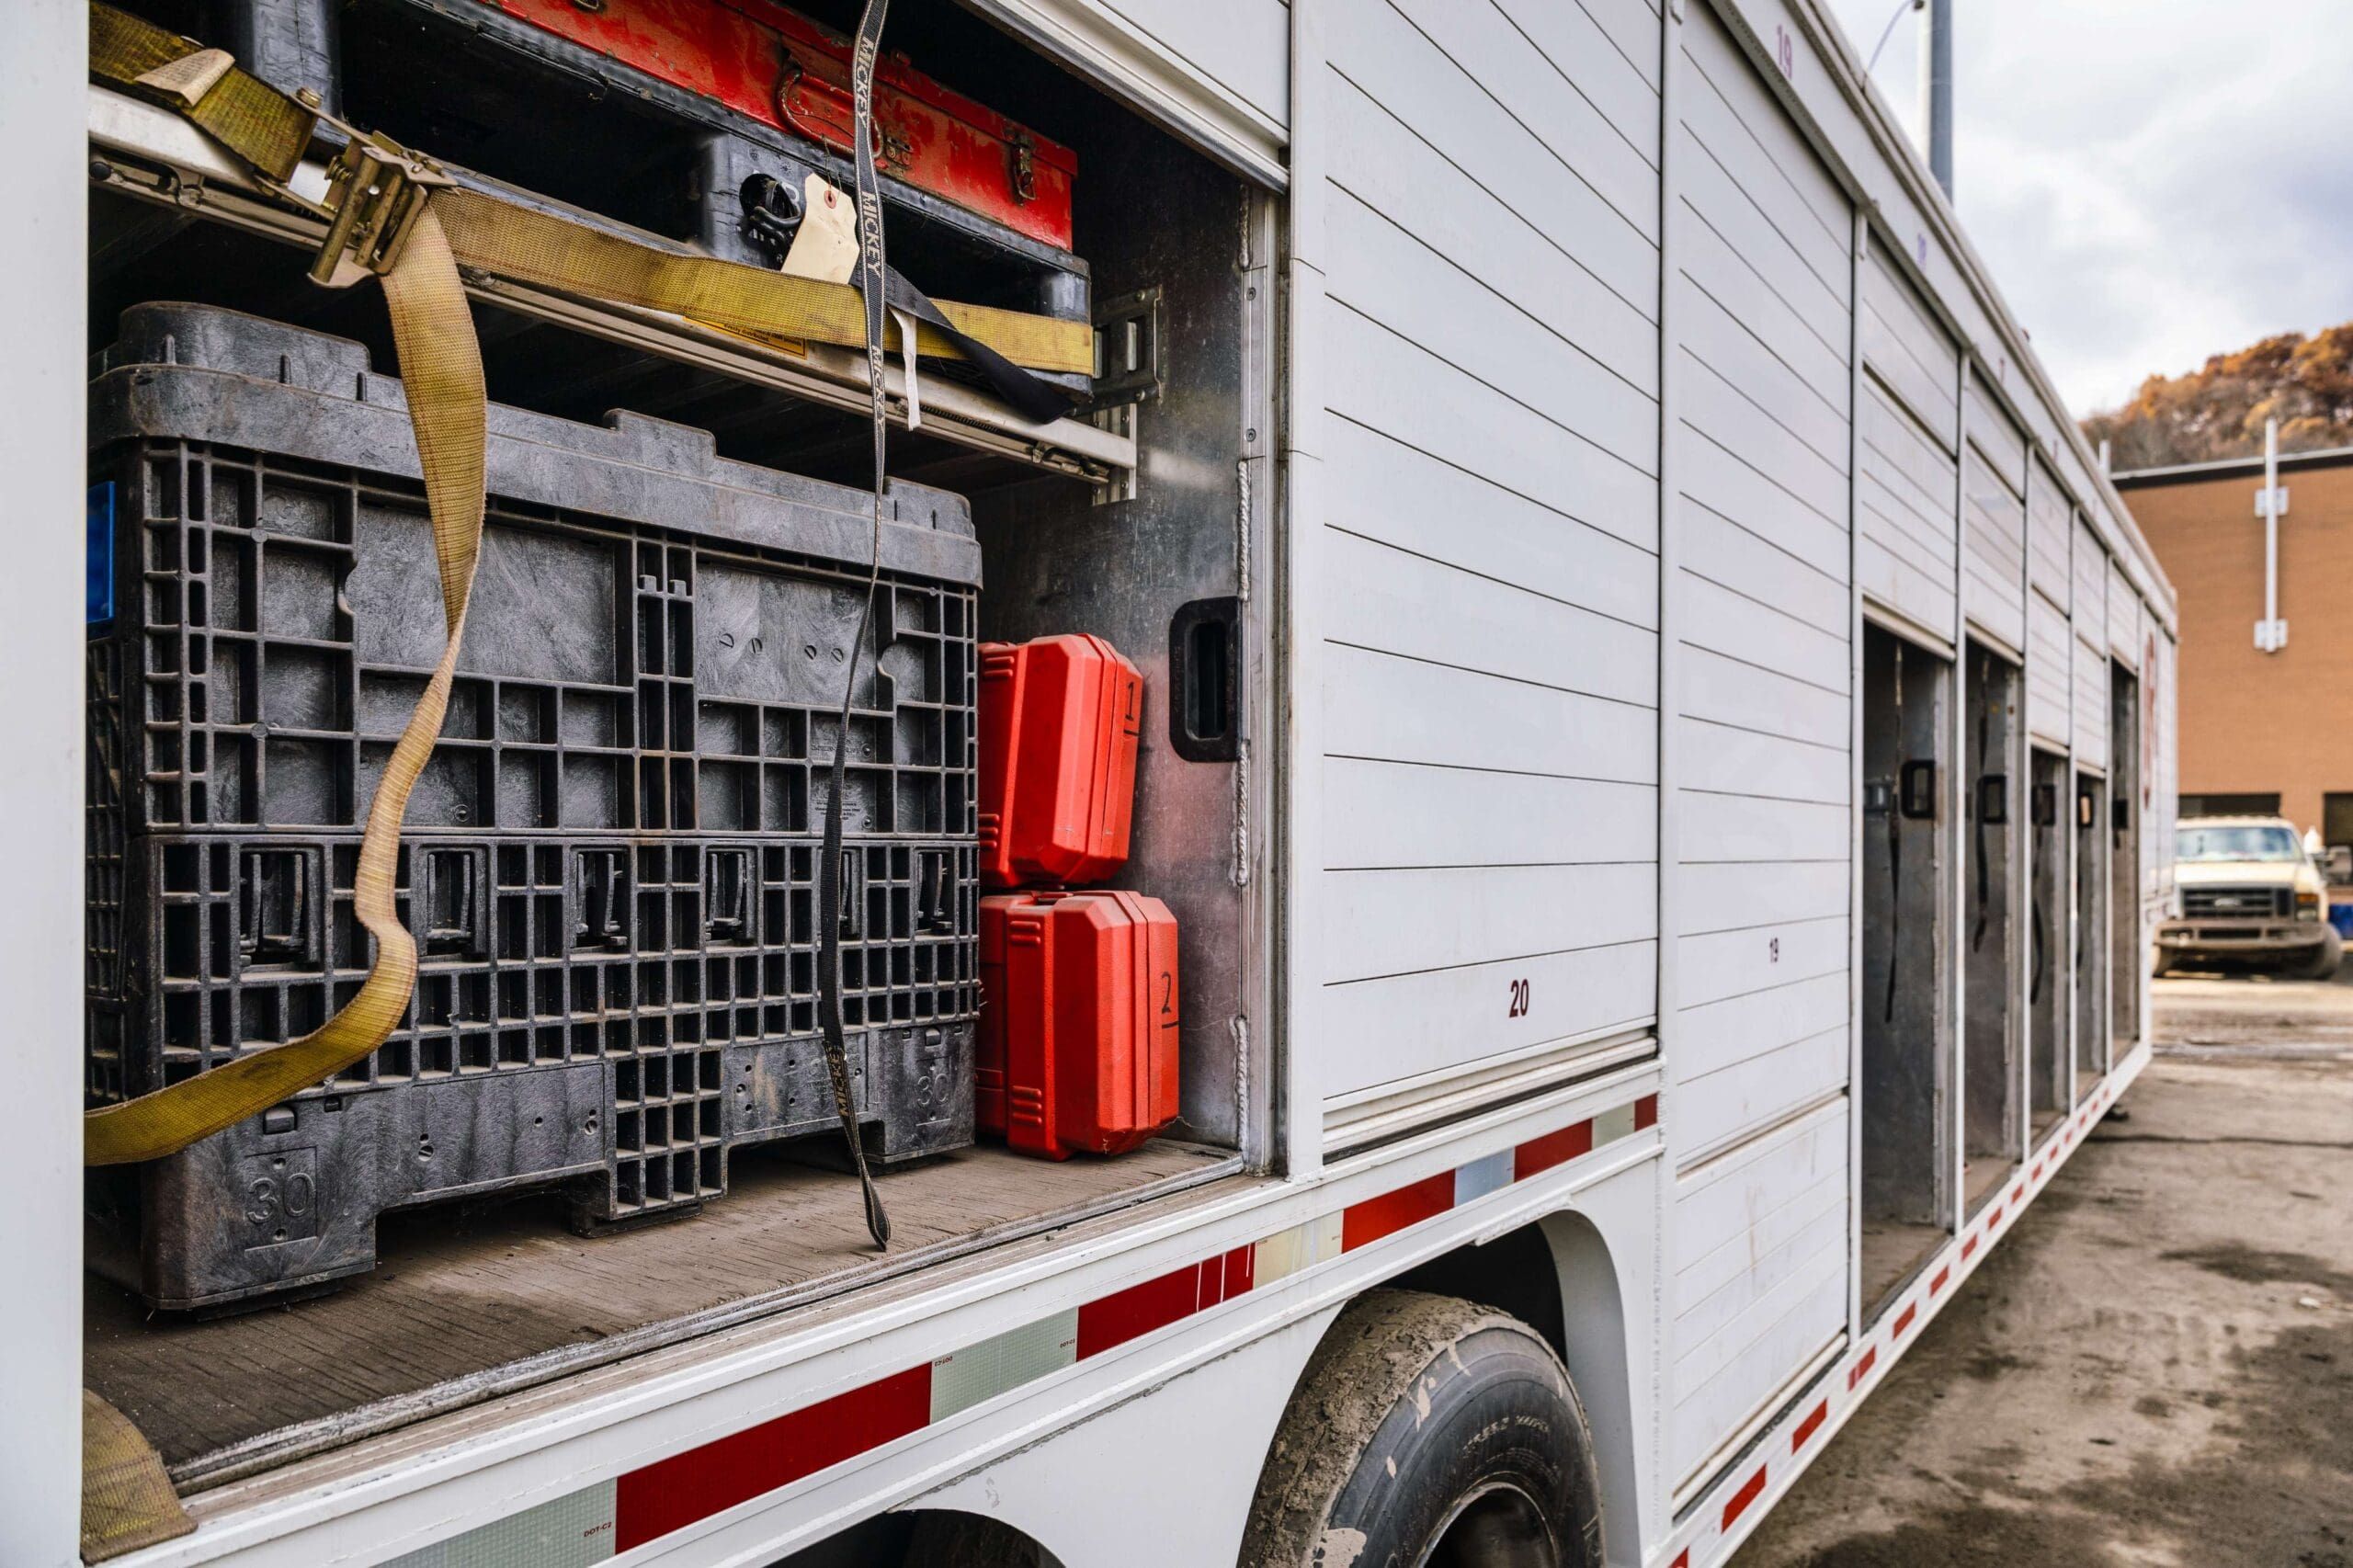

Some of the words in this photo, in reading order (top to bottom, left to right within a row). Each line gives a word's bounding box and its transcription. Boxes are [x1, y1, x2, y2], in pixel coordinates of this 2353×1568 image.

[1776, 23, 1792, 82] 19
[857, 36, 875, 129] MICKEY
[861, 190, 881, 278] MICKEY
[1124, 681, 1134, 722] 1
[1769, 937, 1779, 963] 19
[1161, 971, 1172, 1014] 2
[1509, 978, 1529, 1017] 20
[917, 1074, 949, 1108] 30
[247, 1172, 315, 1224] 30
